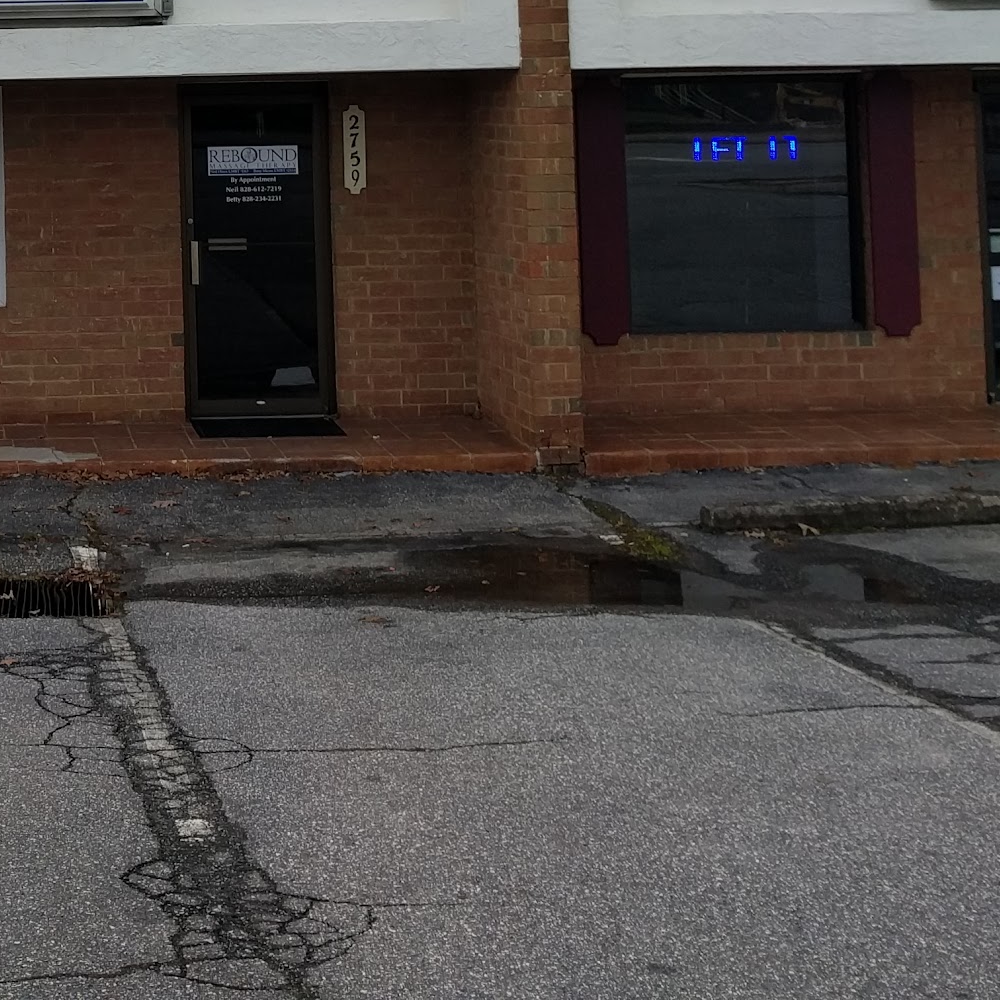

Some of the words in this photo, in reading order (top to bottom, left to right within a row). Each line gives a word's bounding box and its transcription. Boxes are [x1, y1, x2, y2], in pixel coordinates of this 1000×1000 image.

[209, 147, 297, 163] REBOUND
[348, 114, 361, 187] 2759
[230, 176, 238, 184] By
[239, 176, 277, 184] Appointment
[226, 196, 241, 204] Betty
